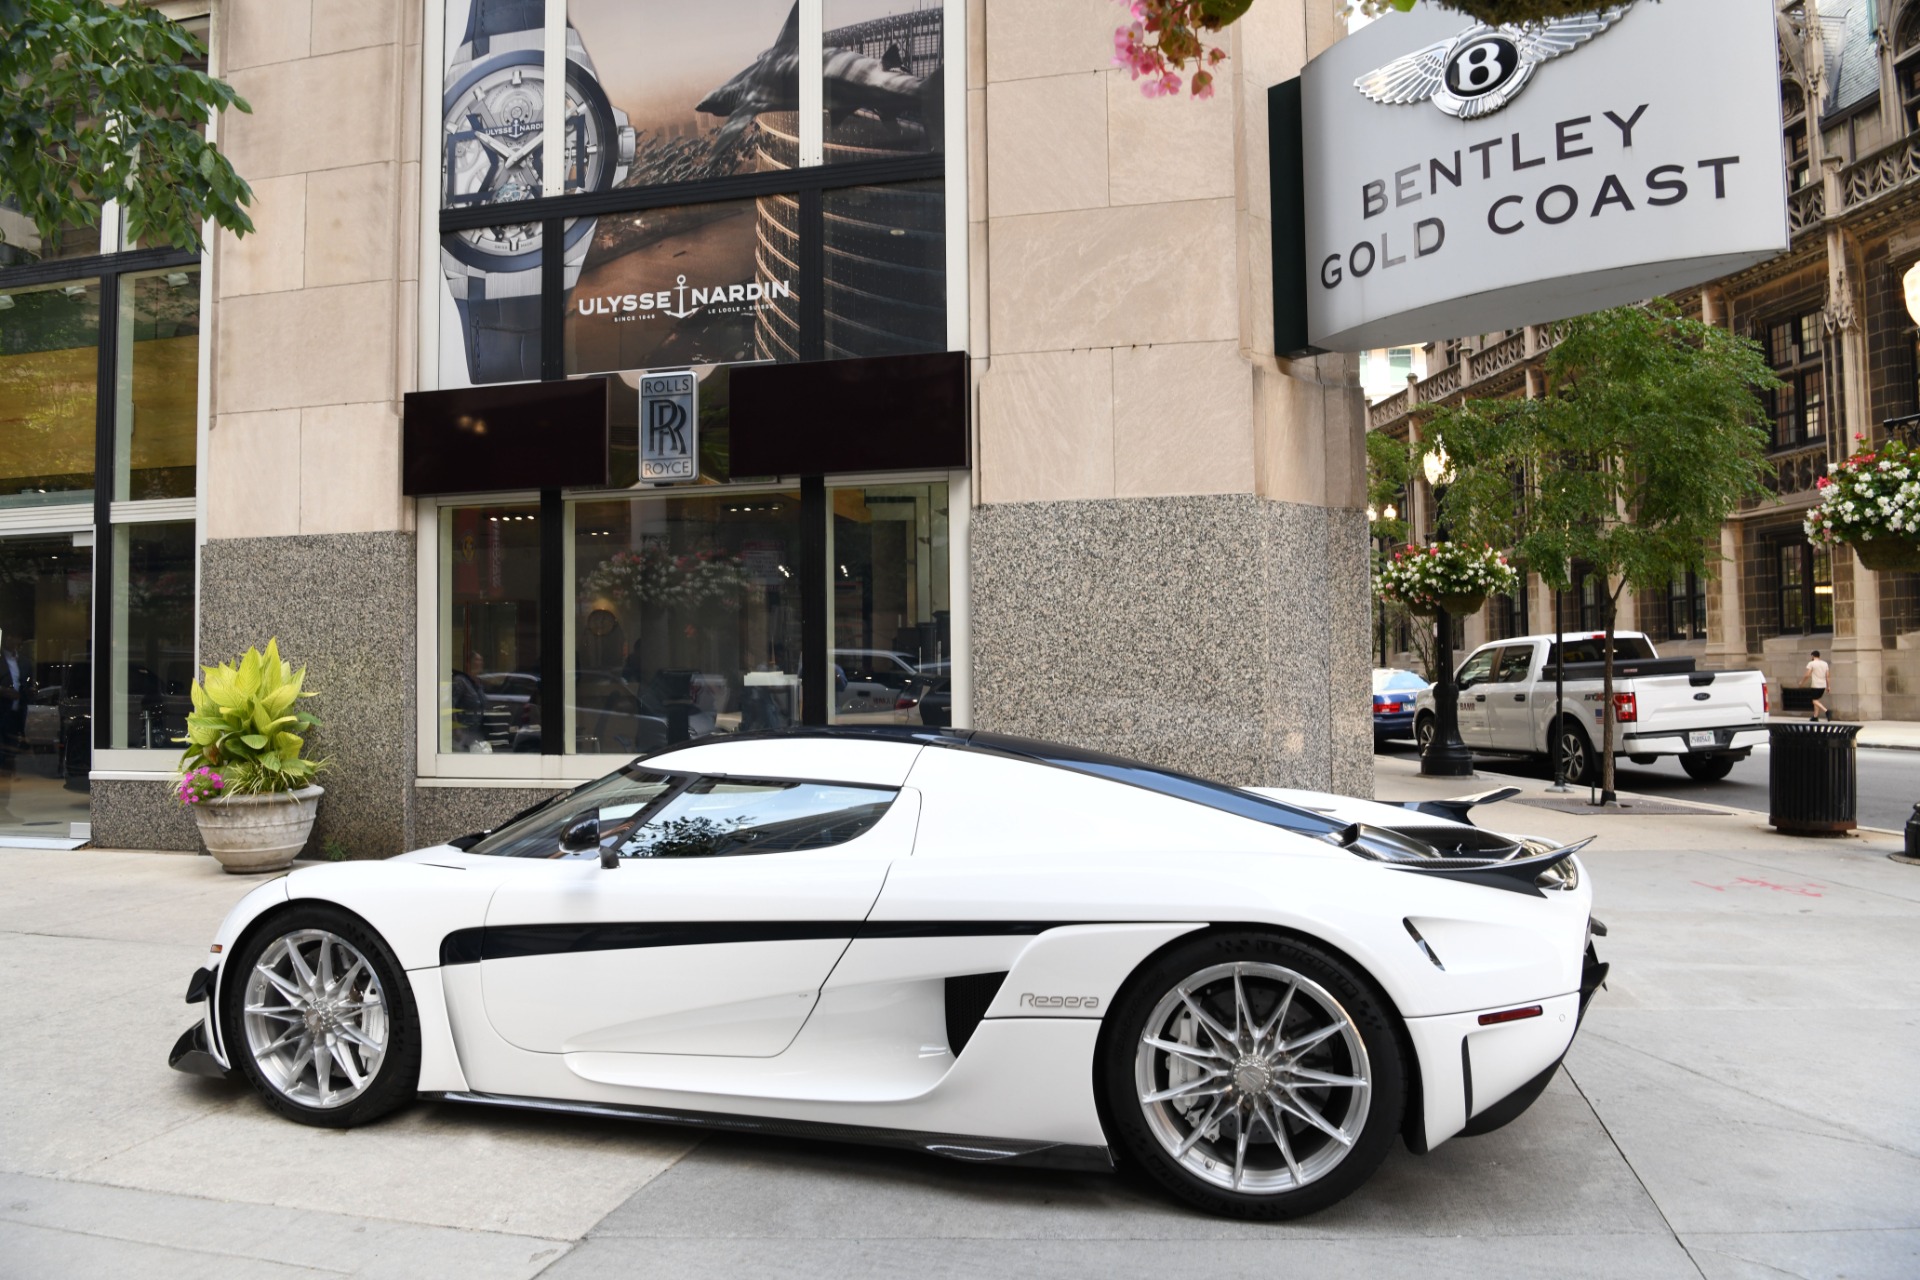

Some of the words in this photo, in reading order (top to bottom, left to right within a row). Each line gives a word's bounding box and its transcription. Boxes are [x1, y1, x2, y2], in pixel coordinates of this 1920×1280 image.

[485, 126, 512, 136] ULYSSE
[520, 123, 543, 132] NARDI
[1363, 103, 1649, 220] BENTLEY
[1320, 217, 1445, 289] GOLD
[1487, 156, 1740, 235] COAST
[579, 291, 671, 315] ULYSSE
[691, 280, 789, 305] NARDIN
[614, 315, 636, 323] SINCE
[645, 379, 689, 394] ROLLS
[645, 461, 689, 476] ROYCE
[1277, 944, 1358, 999] MICHELIN
[1019, 993, 1099, 1008] Regera
